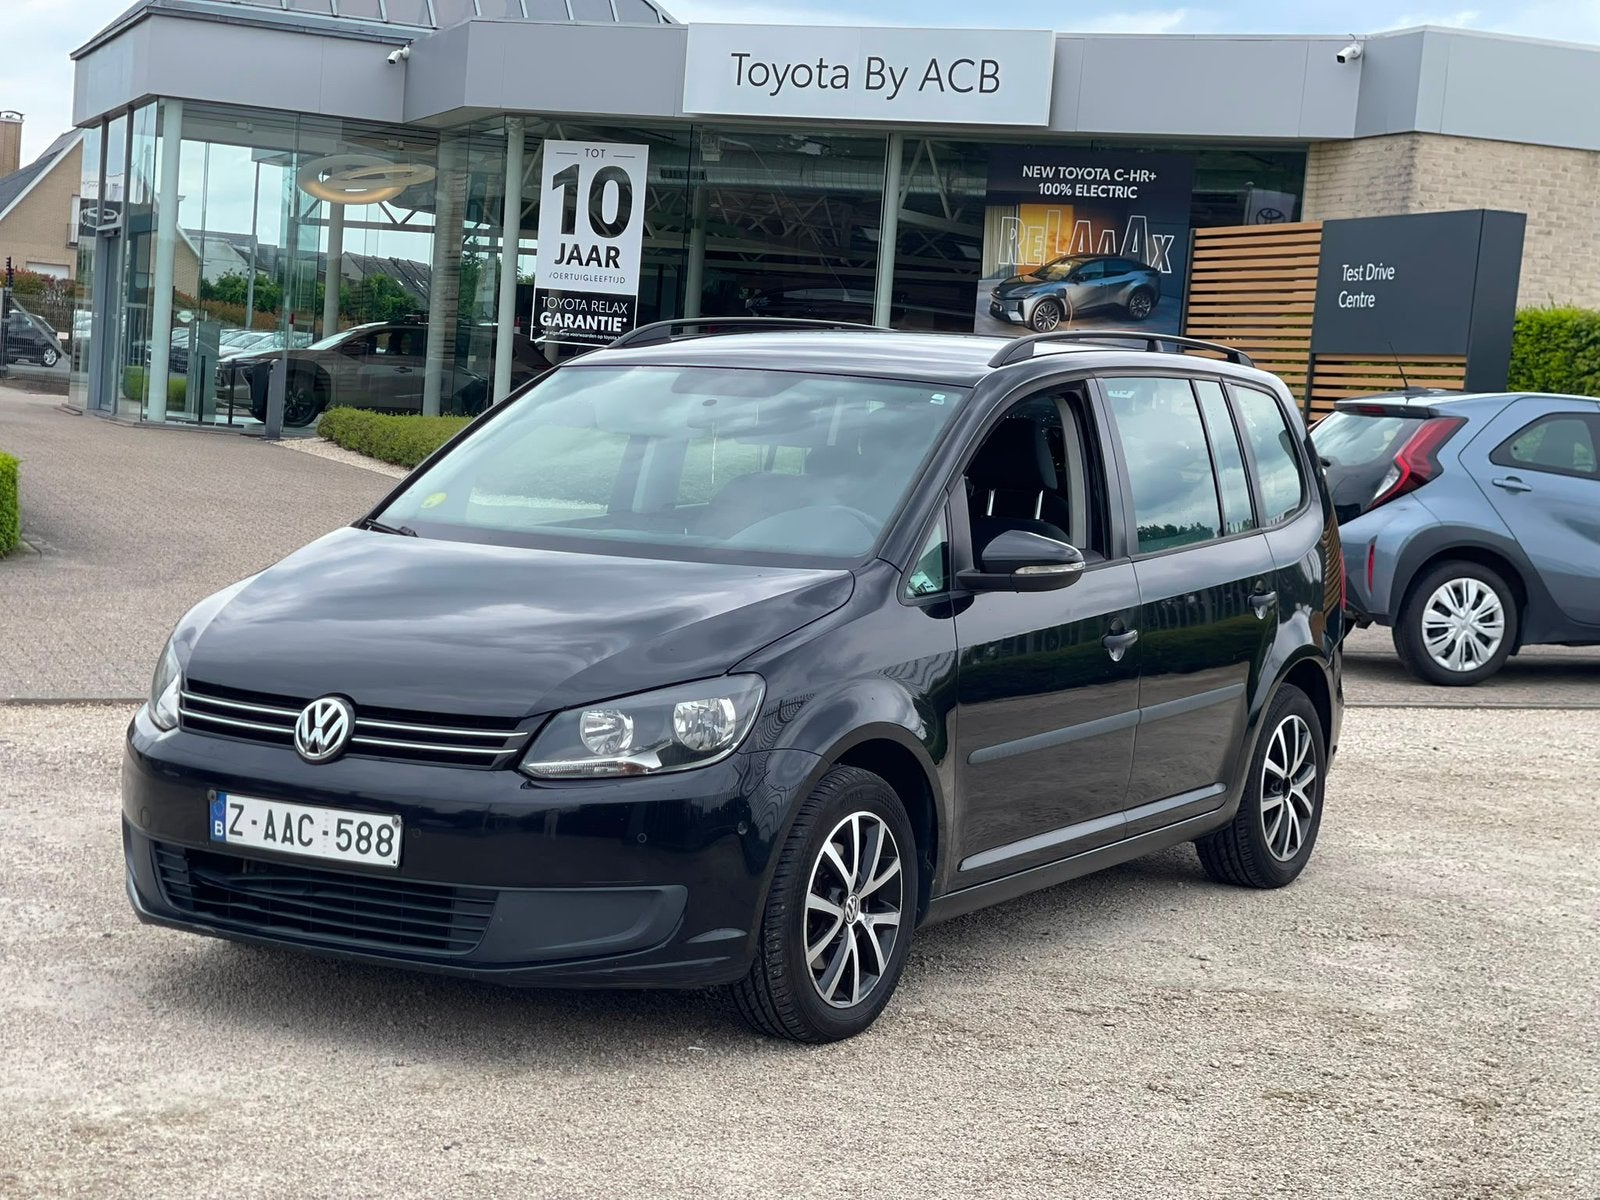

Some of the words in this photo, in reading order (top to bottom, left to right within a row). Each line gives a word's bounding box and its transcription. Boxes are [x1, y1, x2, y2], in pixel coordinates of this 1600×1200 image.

[731, 53, 849, 96] Toyota
[865, 56, 909, 100] By
[918, 58, 1001, 93] ACB
[585, 148, 606, 158] TOT
[1022, 165, 1055, 179] NEW
[1058, 166, 1111, 181] TOYOTA
[1114, 169, 1157, 182] C-HR+
[1038, 182, 1072, 196] 100%
[1075, 184, 1138, 198] ELECTRIC
[552, 164, 633, 238] 10
[554, 243, 620, 269] JAAR
[1342, 264, 1364, 281] Test
[1365, 262, 1395, 281] Drive
[541, 296, 588, 311] TOYOTA
[591, 300, 628, 315] RELAX
[1338, 290, 1376, 308] Centre
[214, 820, 224, 837] B
[228, 803, 395, 858] Z-AAC-588
